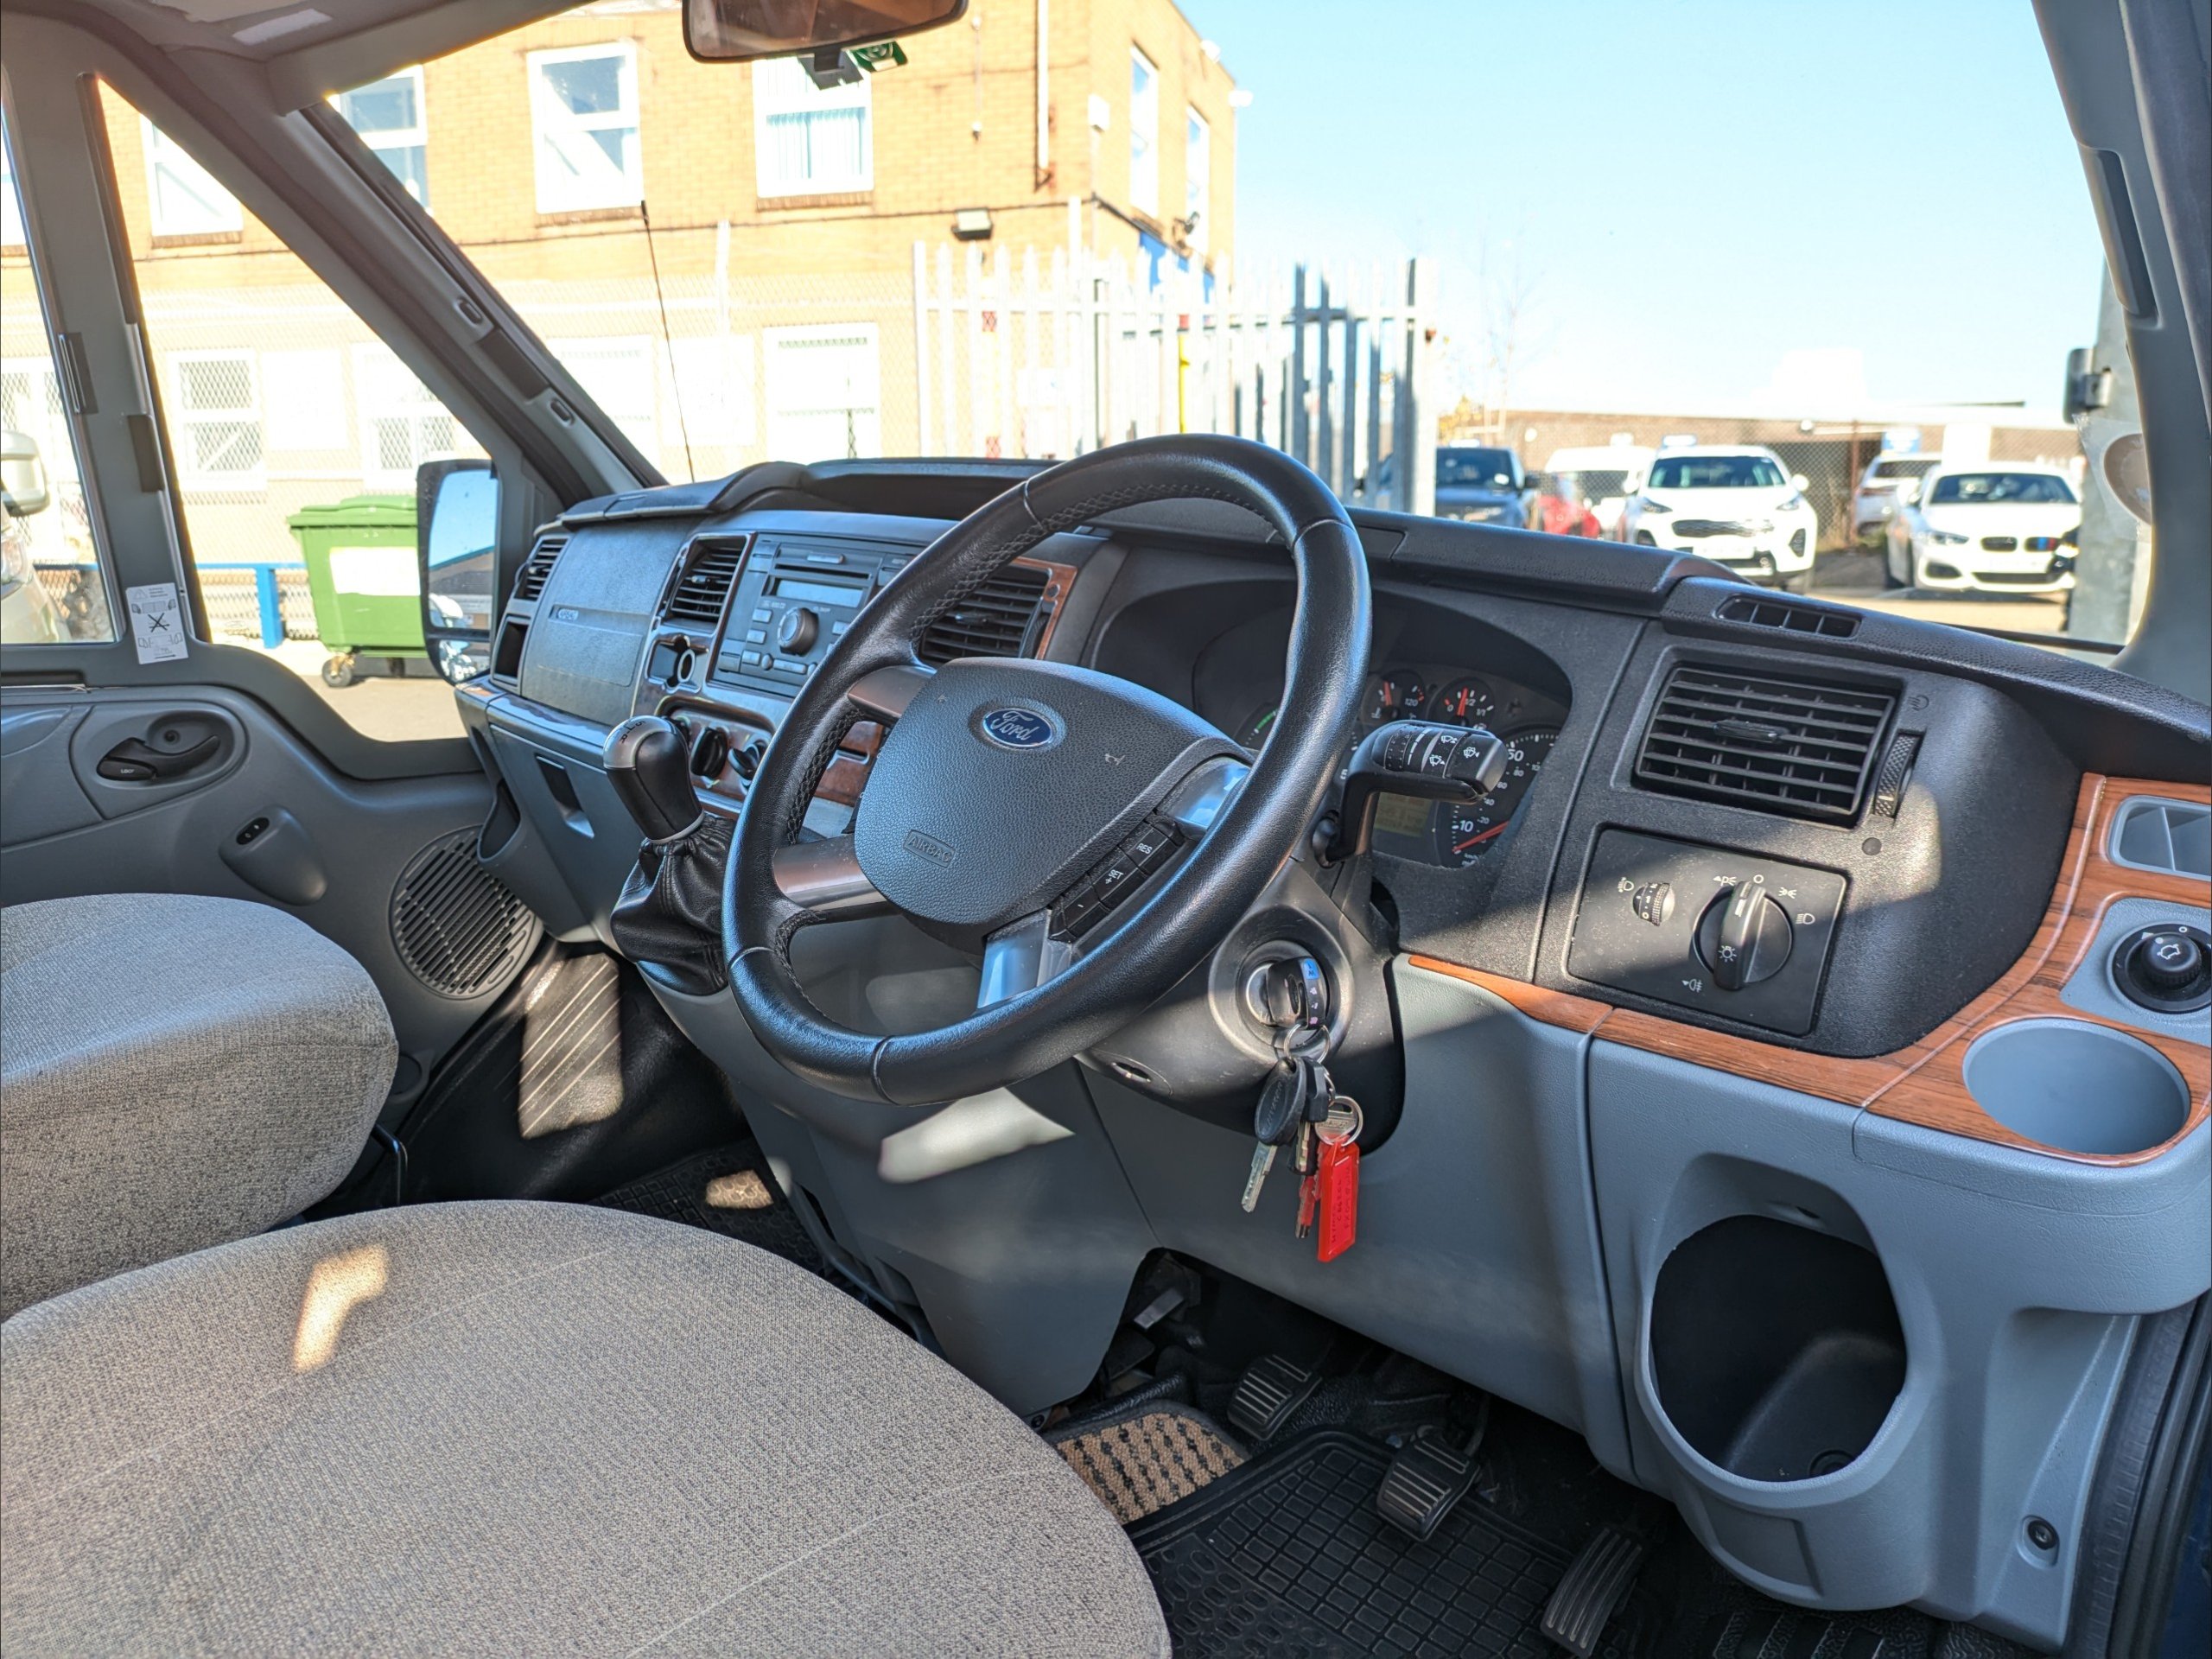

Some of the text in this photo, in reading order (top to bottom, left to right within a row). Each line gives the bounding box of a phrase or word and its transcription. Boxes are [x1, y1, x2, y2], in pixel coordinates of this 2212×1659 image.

[1405, 698, 1419, 707] 120
[990, 710, 1039, 741] Ford
[1459, 819, 1474, 833] 10
[908, 836, 951, 863] AIRBAG
[1136, 842, 1153, 855] RES
